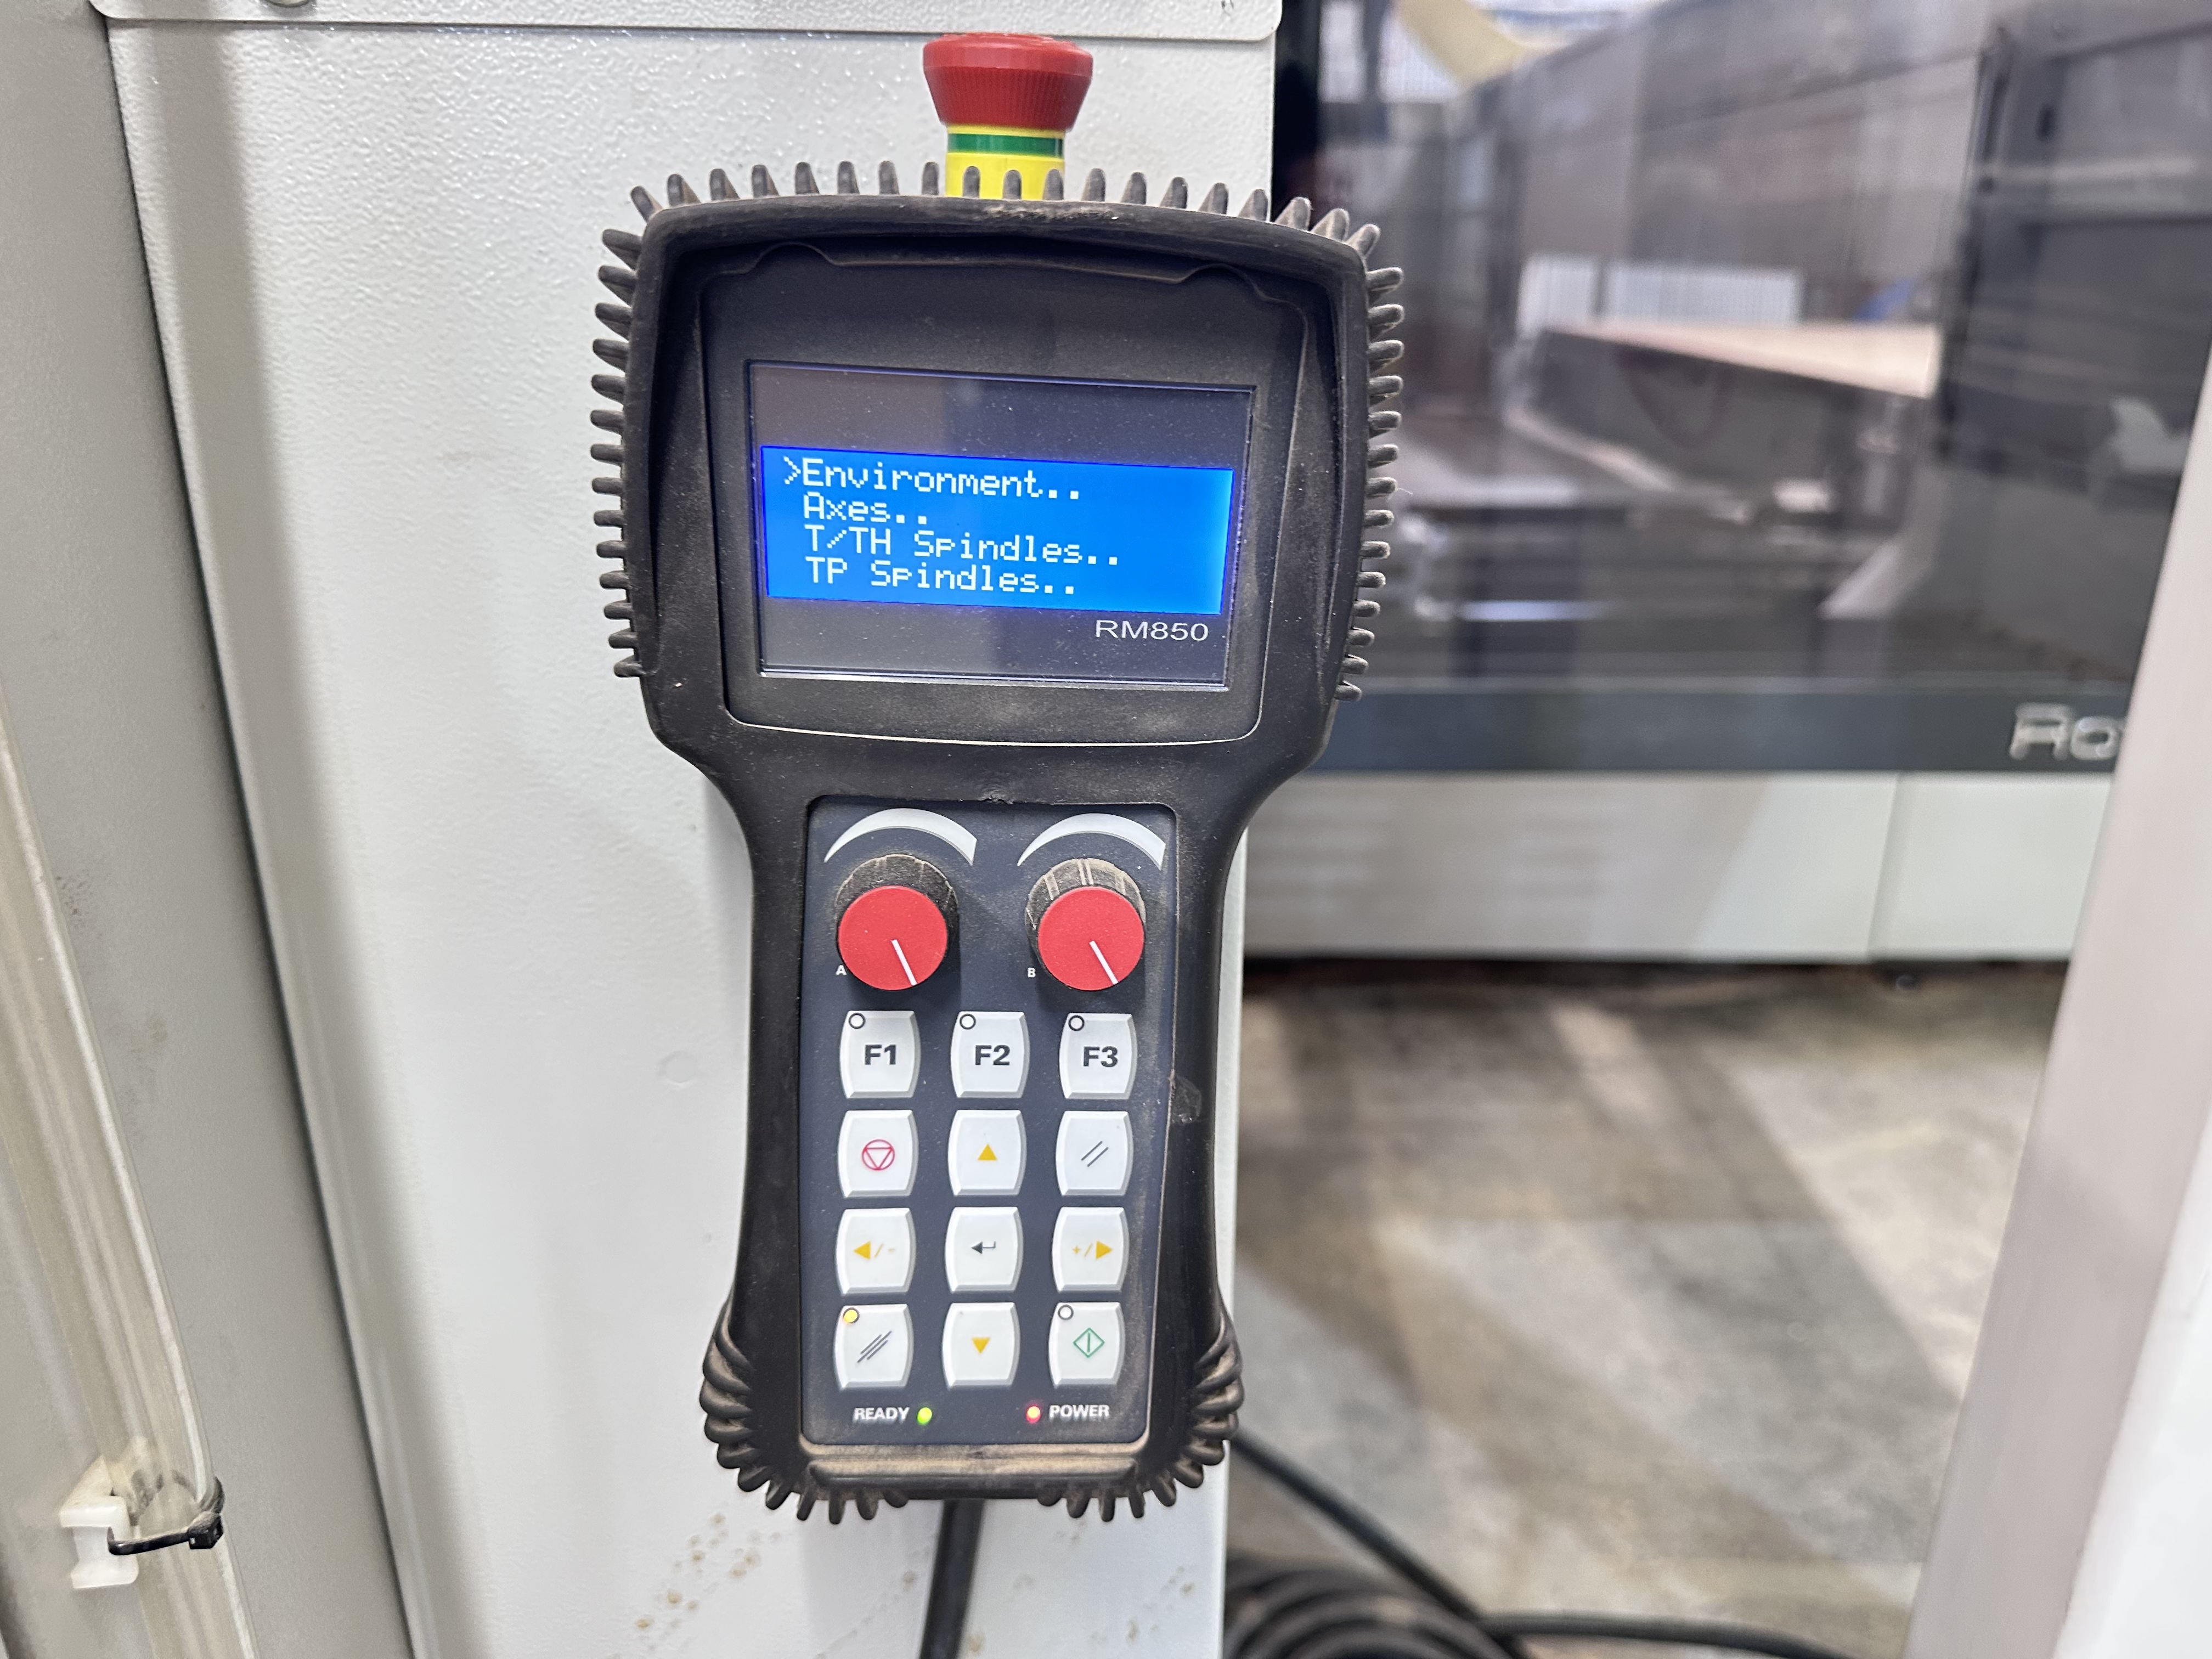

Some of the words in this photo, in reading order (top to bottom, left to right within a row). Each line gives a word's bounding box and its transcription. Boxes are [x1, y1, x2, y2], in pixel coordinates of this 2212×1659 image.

[804, 492, 928, 524] Axes..
[805, 525, 892, 556] T/TH
[914, 530, 1119, 566] Spindles..
[805, 556, 848, 585] TP
[871, 560, 1075, 596] Spindles..
[1094, 619, 1210, 642] RM850
[2009, 702, 2128, 761] Ro
[835, 966, 847, 977] A
[1027, 967, 1036, 978] B
[864, 1044, 898, 1066] F1
[974, 1045, 1012, 1066] F2
[1082, 1046, 1119, 1069] F3
[853, 1407, 911, 1422] READY
[1048, 1404, 1110, 1419] POWER
